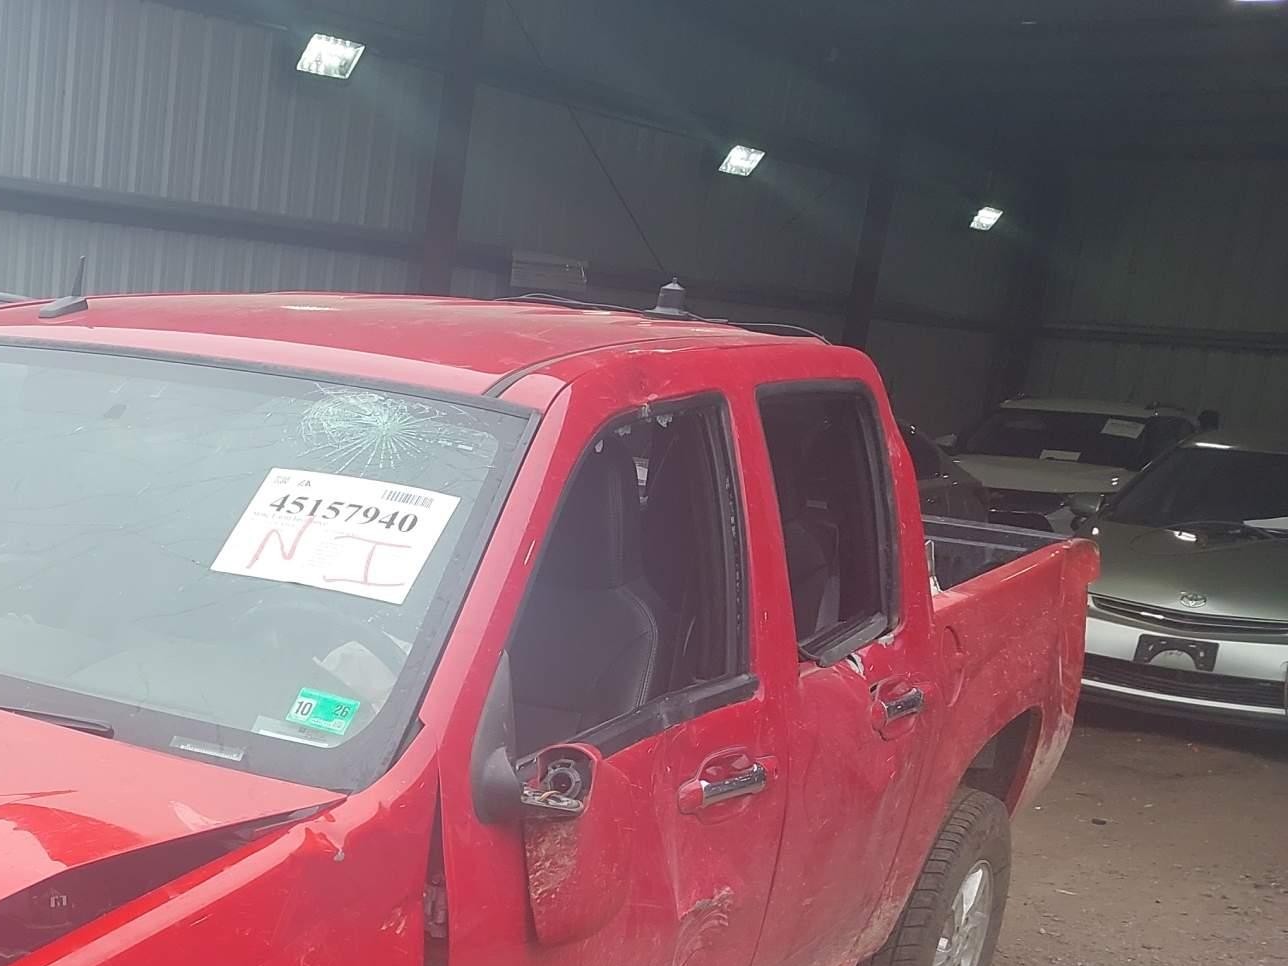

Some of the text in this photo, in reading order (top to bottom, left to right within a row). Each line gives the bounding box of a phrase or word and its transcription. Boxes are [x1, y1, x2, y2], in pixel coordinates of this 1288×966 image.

[269, 493, 418, 533] 45157940
[294, 700, 351, 719] 10 26
